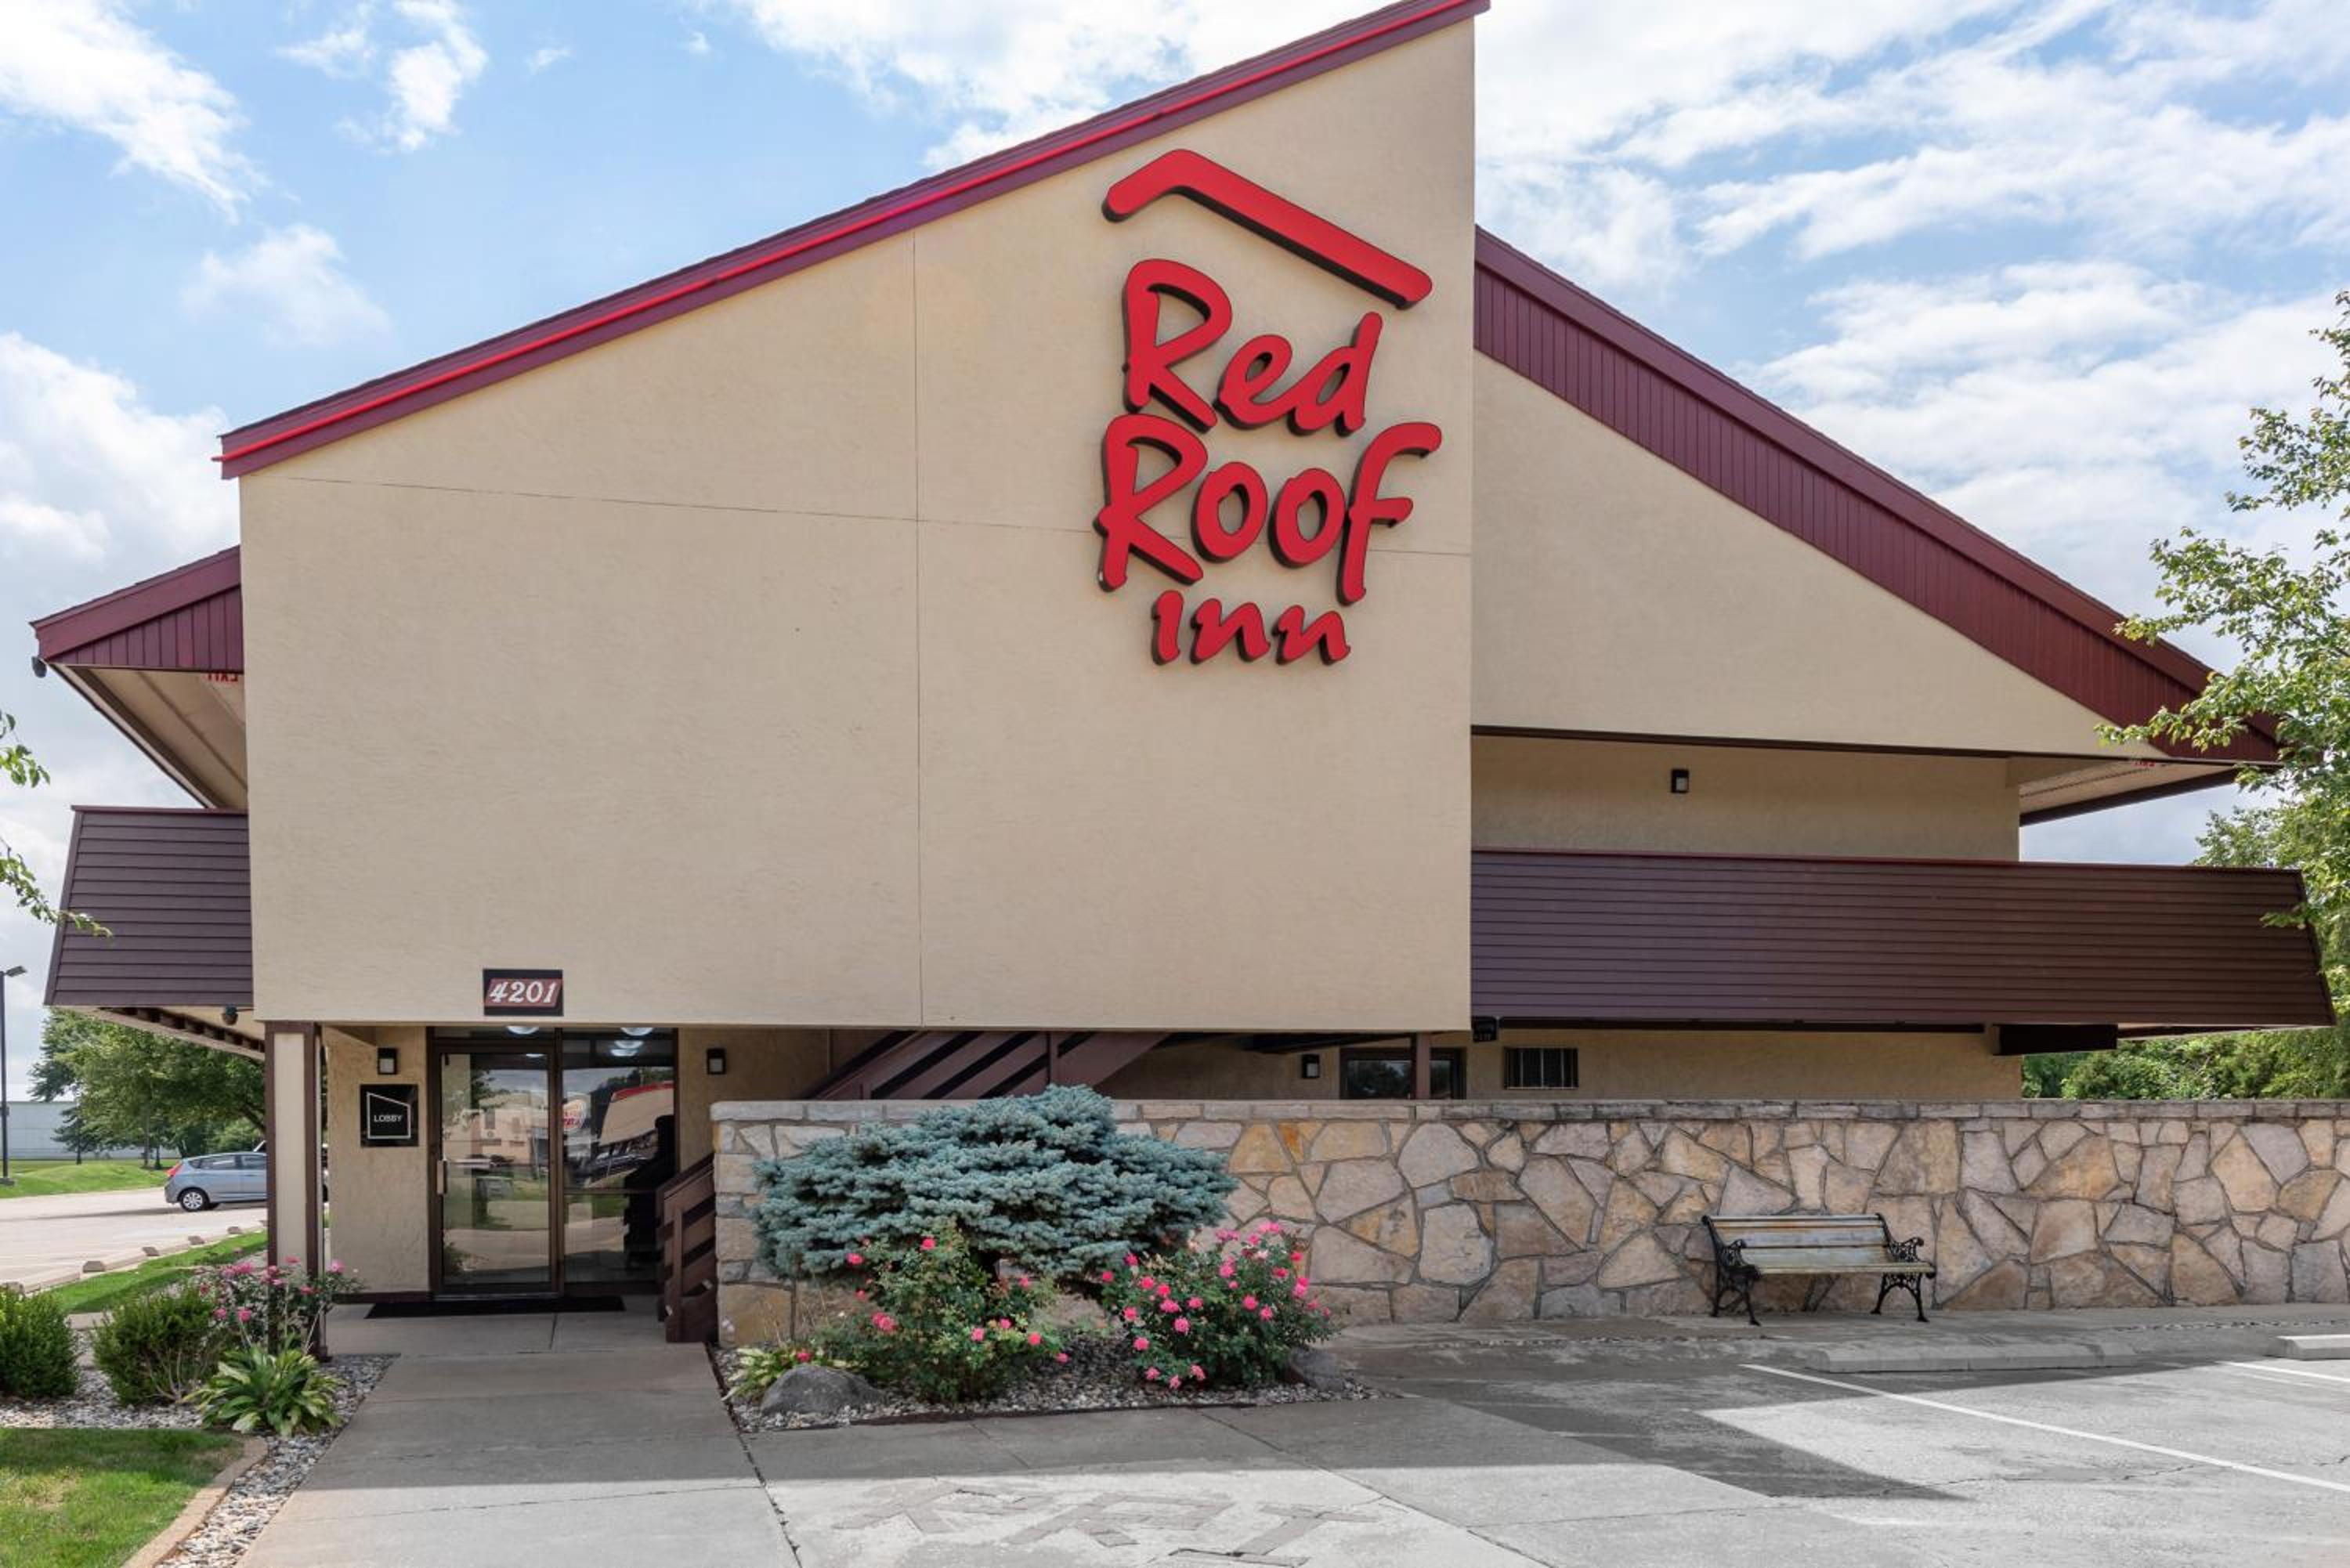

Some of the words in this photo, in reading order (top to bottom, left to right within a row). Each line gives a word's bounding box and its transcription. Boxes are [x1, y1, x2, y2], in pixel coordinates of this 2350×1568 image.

[1122, 258, 1383, 437] Red
[1093, 413, 1442, 606] Roof
[489, 981, 557, 1003] 4201
